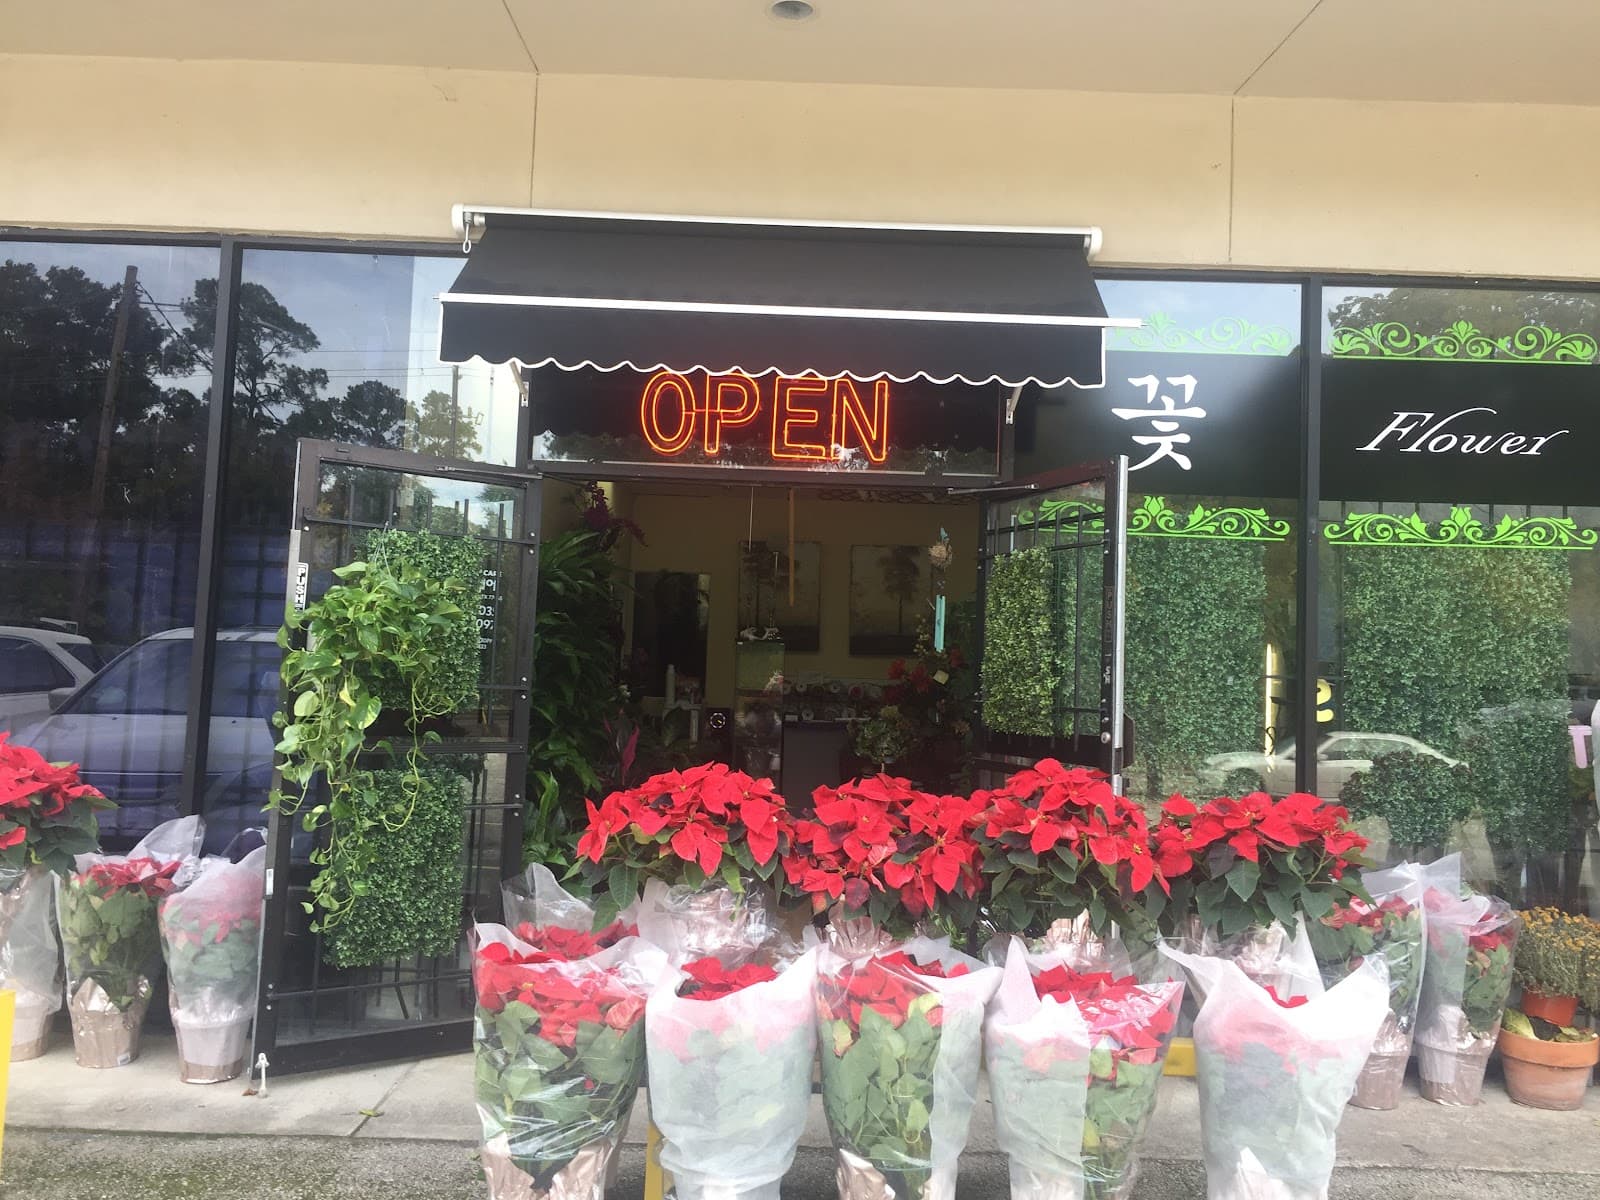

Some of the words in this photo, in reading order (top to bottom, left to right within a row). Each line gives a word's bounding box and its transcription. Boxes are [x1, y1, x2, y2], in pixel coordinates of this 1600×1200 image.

[640, 371, 888, 462] OPEN
[1111, 374, 1207, 471] 꽃
[1355, 407, 1570, 455] Flower
[295, 567, 306, 605] PUSH
